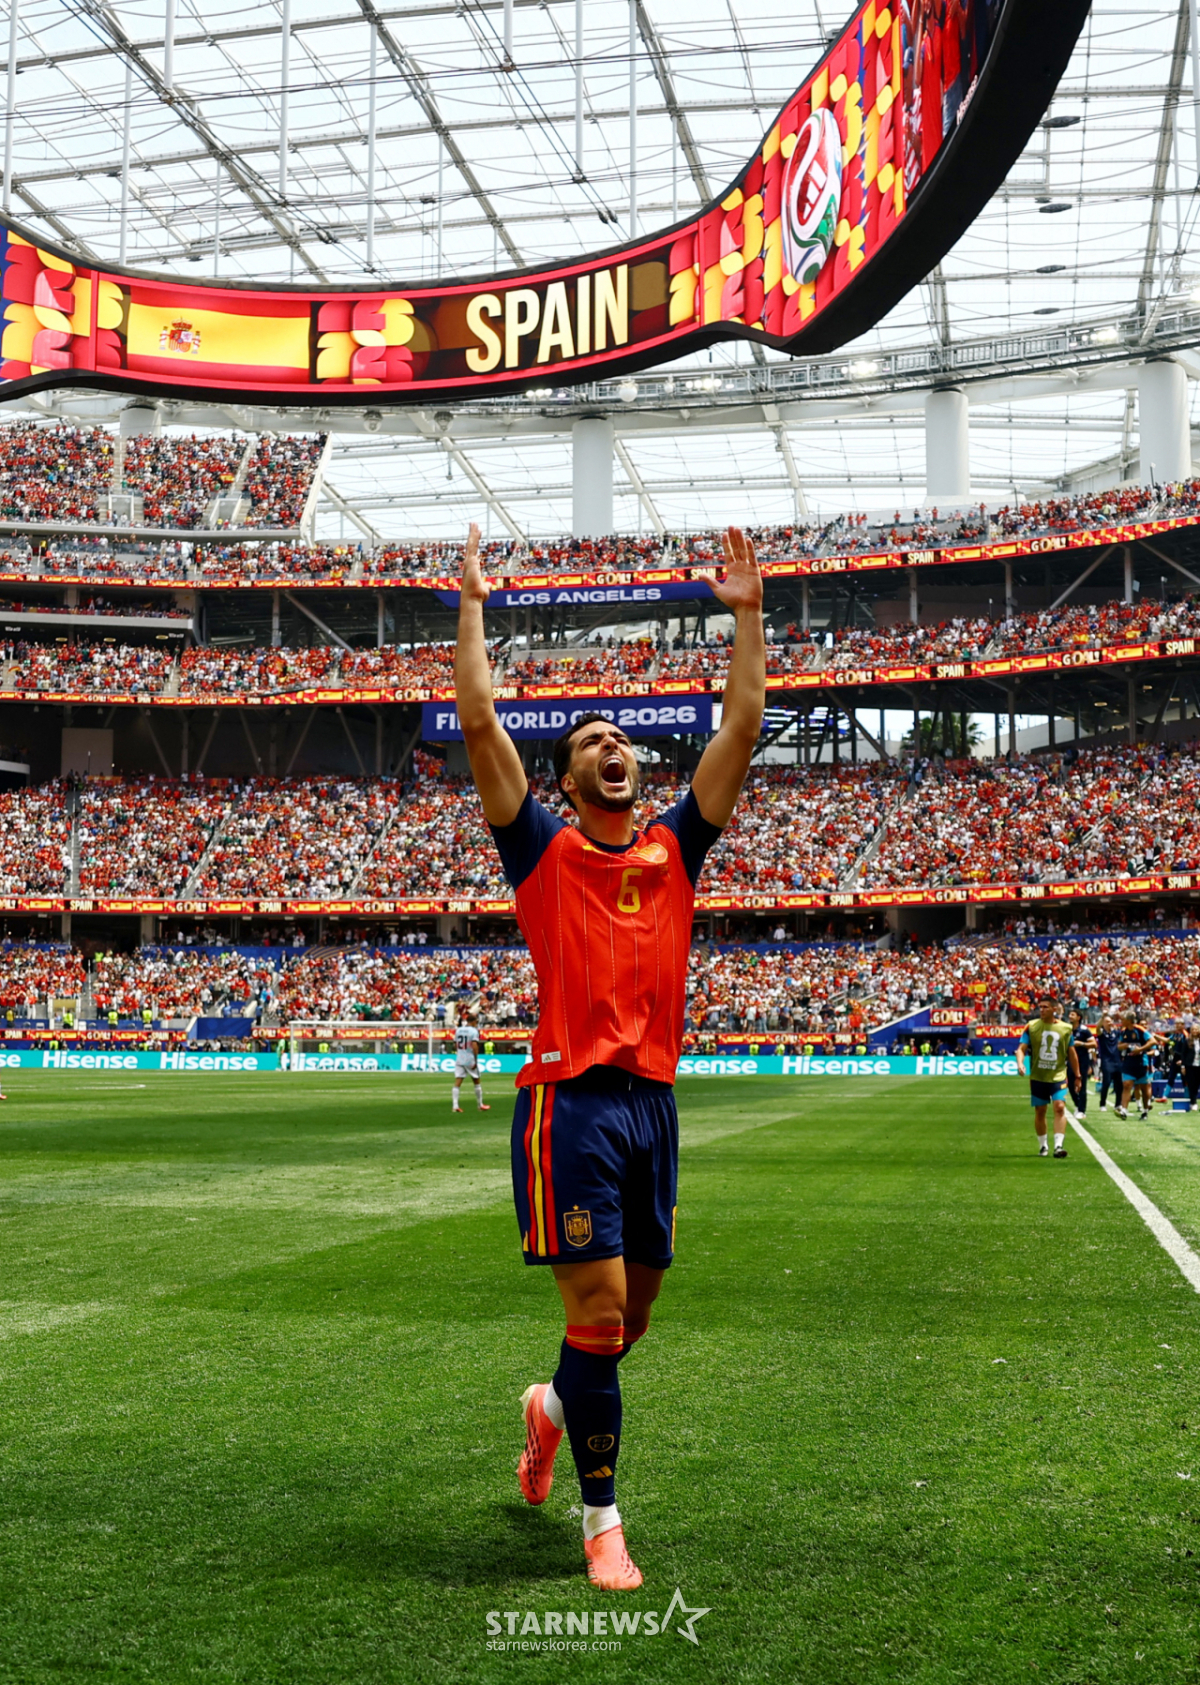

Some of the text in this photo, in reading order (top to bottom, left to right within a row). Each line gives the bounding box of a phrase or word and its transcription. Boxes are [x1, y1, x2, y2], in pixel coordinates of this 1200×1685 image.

[465, 264, 629, 373] SPAIN
[1031, 537, 1067, 551] GOAL!
[907, 551, 934, 565] SPAIN
[811, 559, 847, 572] GOAL!
[597, 573, 632, 585] GOAL!
[506, 588, 662, 606] LOS ANGELES
[1166, 640, 1195, 655] SPAIN
[1063, 651, 1100, 665] GOAL!
[937, 664, 965, 677] SPAIN
[835, 672, 873, 684] GOAL!
[613, 682, 650, 694] GOAL!
[710, 679, 727, 691] SPA
[395, 689, 431, 701] GOAL!
[492, 687, 517, 699] SPAIN
[436, 713, 461, 730] FI
[570, 709, 615, 727] CP
[618, 706, 697, 727] 2026
[1086, 882, 1116, 894] GOAL!
[1168, 875, 1191, 889] SPAIN
[617, 868, 643, 913] 6
[936, 890, 967, 901] GOAL!
[1021, 886, 1044, 898] SPAIN
[70, 900, 93, 911] SPAIN
[259, 901, 282, 912] SPAIN
[448, 901, 471, 912] SPAIN
[744, 896, 775, 908] GOAL!
[829, 894, 853, 906] SPAIN
[176, 902, 207, 912] GOAL!
[364, 902, 395, 912] GOAL!
[933, 1010, 963, 1023] GOAL!
[4, 1030, 23, 1039] SPAIN
[457, 1035, 468, 1050] 21
[42, 1051, 138, 1069] Hisense
[160, 1052, 258, 1070] Hisense
[401, 1054, 501, 1072] Hisese
[782, 1056, 890, 1075] Hisense
[915, 1056, 1019, 1076] Hisense
[677, 1059, 757, 1075] sense
